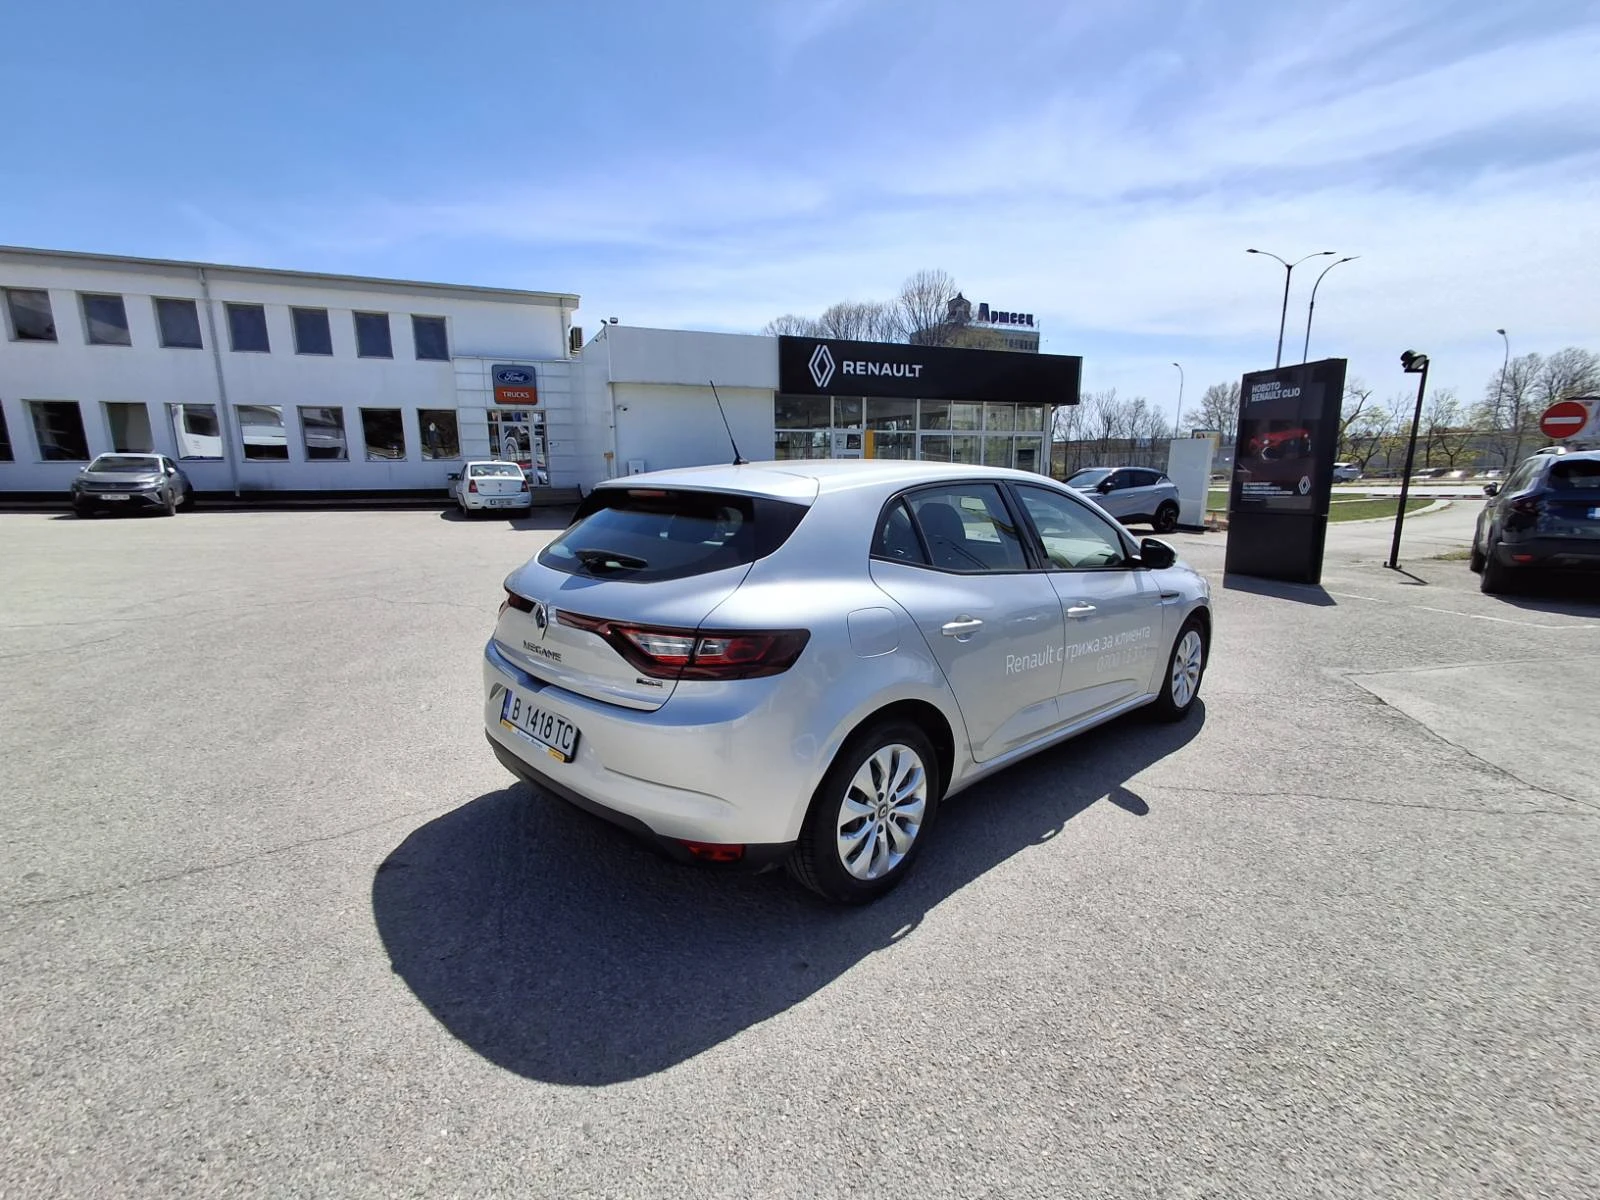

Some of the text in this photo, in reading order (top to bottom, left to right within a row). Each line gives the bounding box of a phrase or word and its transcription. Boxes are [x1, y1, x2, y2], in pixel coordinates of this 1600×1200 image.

[977, 302, 1034, 327] Армеец
[504, 371, 525, 383] Ford
[842, 361, 923, 378] RENAULT
[502, 391, 530, 399] TRUCKS
[1251, 381, 1280, 394] НОВОТО
[1251, 387, 1301, 402] RENAULT CLIO
[523, 640, 562, 662] MEGANE
[1006, 645, 1054, 675] Renault
[1101, 635, 1113, 650] за
[512, 698, 521, 721] B
[525, 705, 554, 739] 1418
